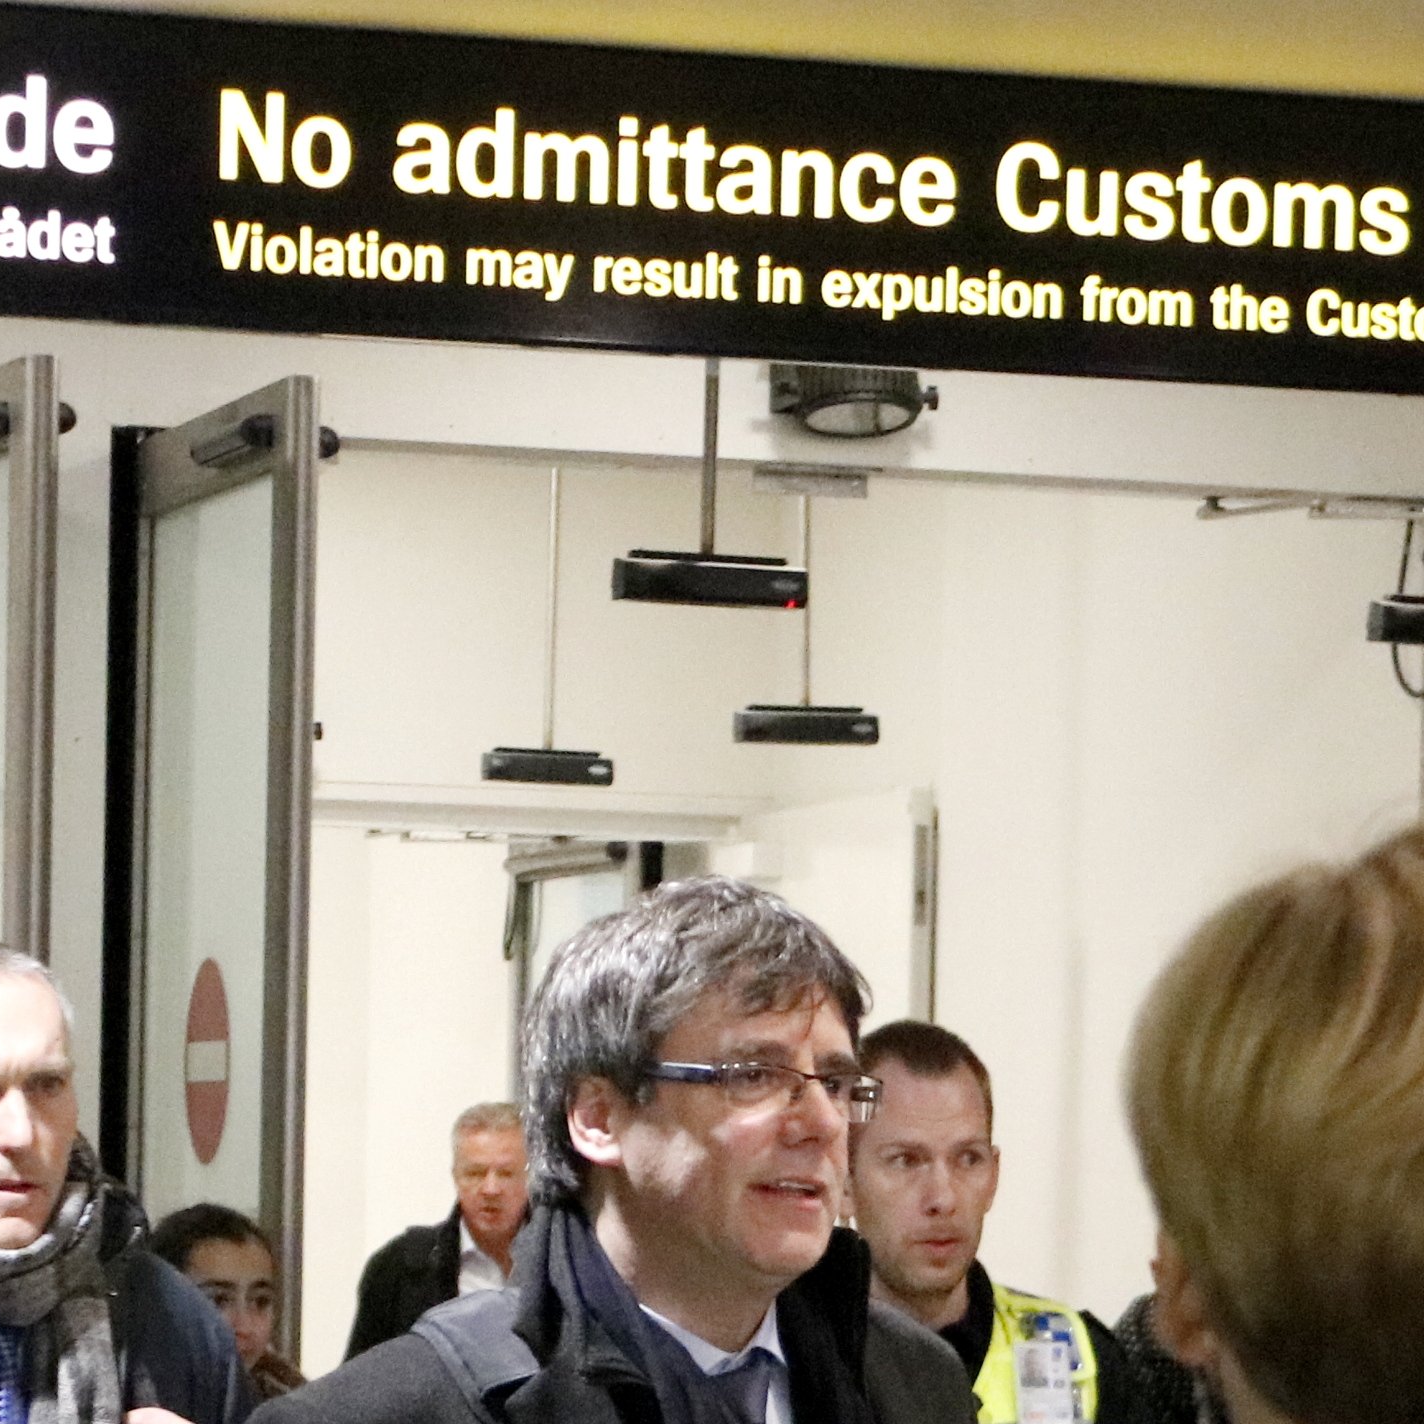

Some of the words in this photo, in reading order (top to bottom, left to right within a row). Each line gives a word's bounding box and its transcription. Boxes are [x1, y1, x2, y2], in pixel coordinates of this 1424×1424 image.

[219, 88, 352, 190] No
[392, 107, 957, 228] admittance
[995, 141, 1410, 257] Customs
[212, 220, 445, 284] Violation
[465, 248, 575, 302] may
[593, 250, 740, 302] result
[757, 254, 803, 305] in
[821, 264, 1064, 321] expulsion
[1079, 274, 1194, 328] from
[1209, 283, 1290, 334] the
